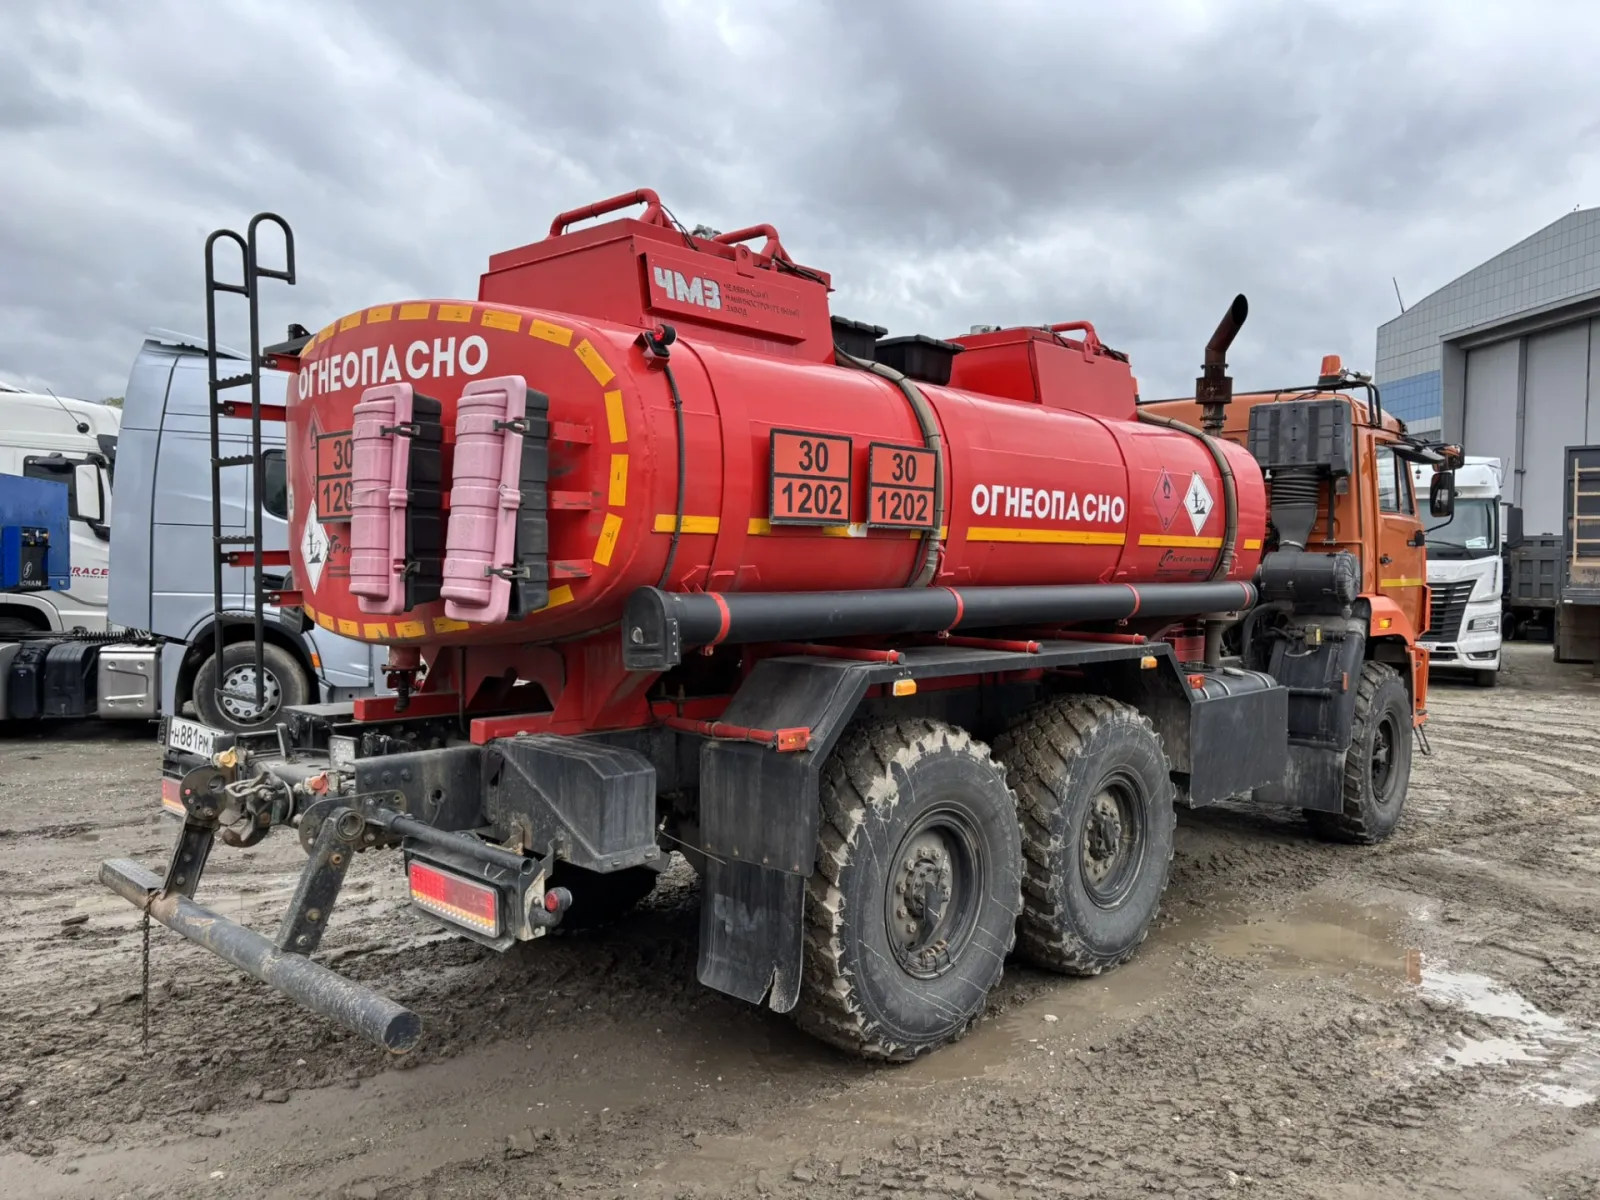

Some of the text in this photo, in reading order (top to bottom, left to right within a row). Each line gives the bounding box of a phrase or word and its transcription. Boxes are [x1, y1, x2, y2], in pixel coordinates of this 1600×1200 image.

[653, 266, 722, 310] ЧМЗ
[298, 335, 489, 400] ОГНЕОПАСНО
[798, 440, 829, 473] 30
[891, 453, 917, 482] 30
[323, 482, 354, 513] 120
[782, 482, 842, 515] 1202
[877, 490, 928, 521] 1202
[971, 483, 1125, 523] ОГНЕОПАСНО
[70, 566, 110, 577] RACE
